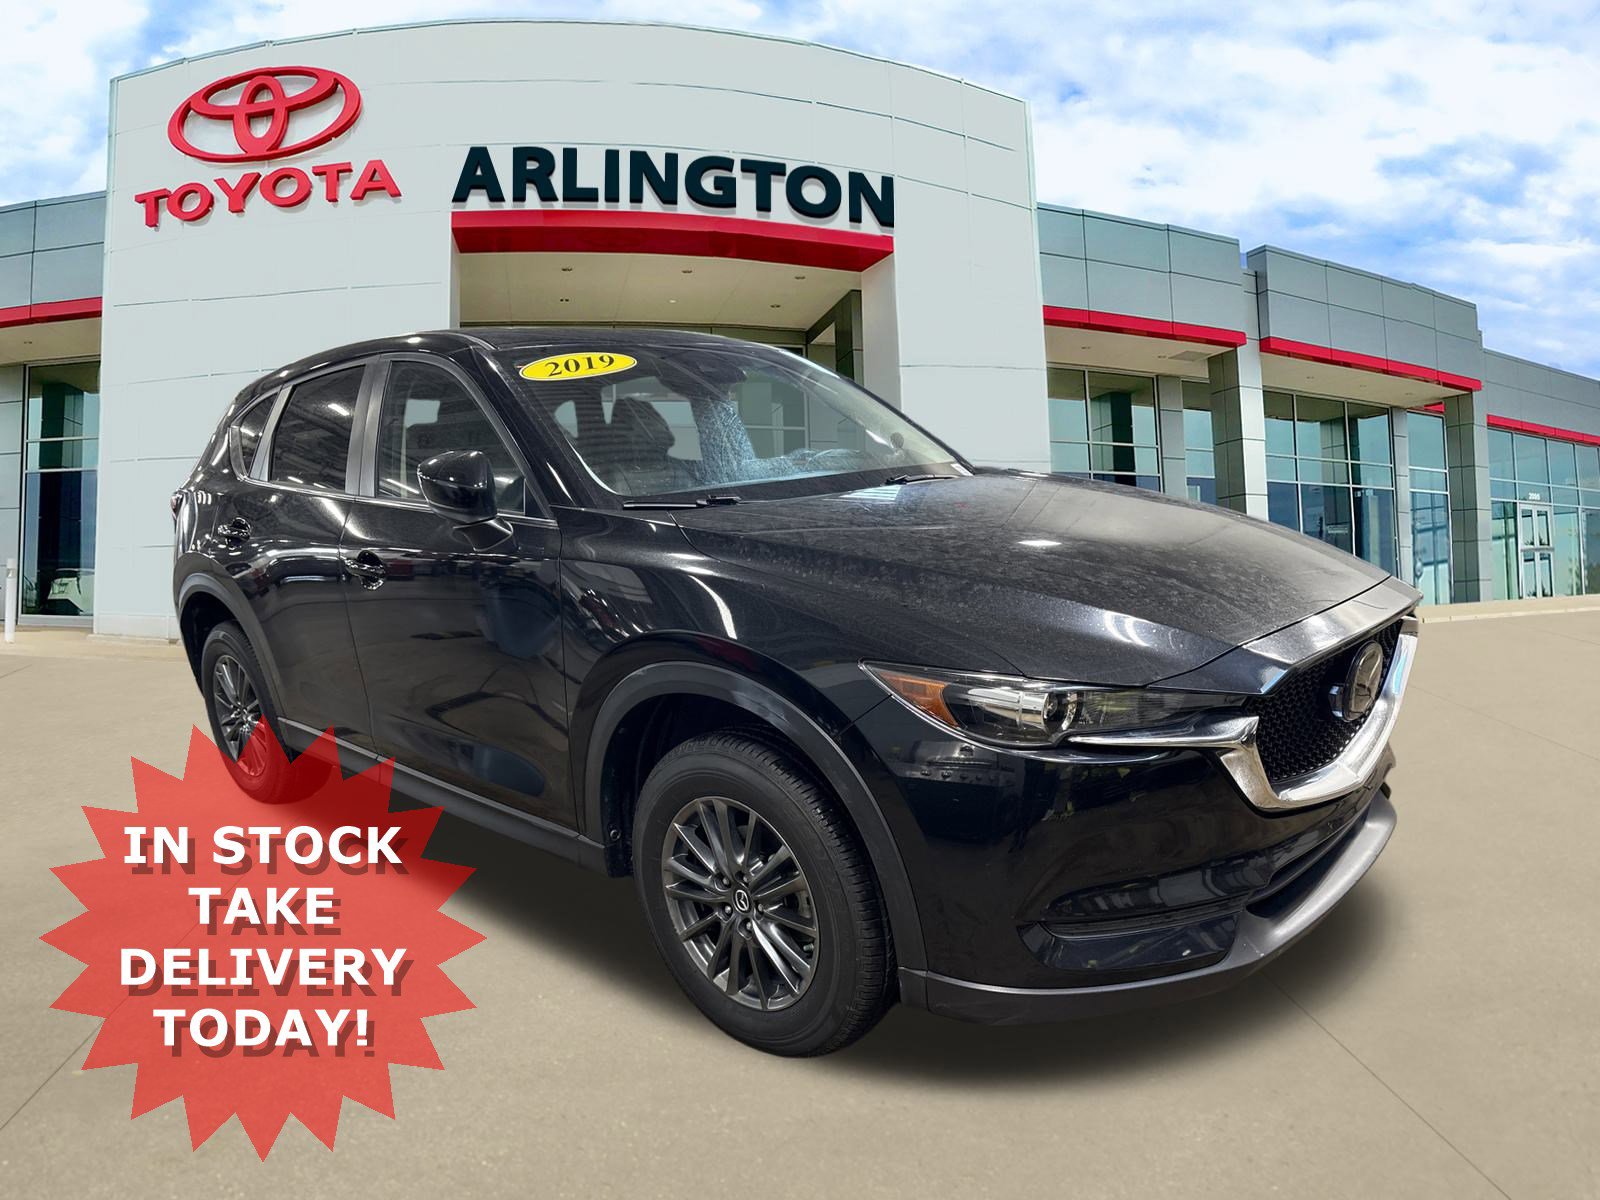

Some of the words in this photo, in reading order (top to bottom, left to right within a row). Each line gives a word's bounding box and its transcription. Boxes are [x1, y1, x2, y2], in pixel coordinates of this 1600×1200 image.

[135, 159, 402, 228] TOYOTA
[452, 146, 895, 228] ARLINGTON
[545, 355, 615, 377] 2019
